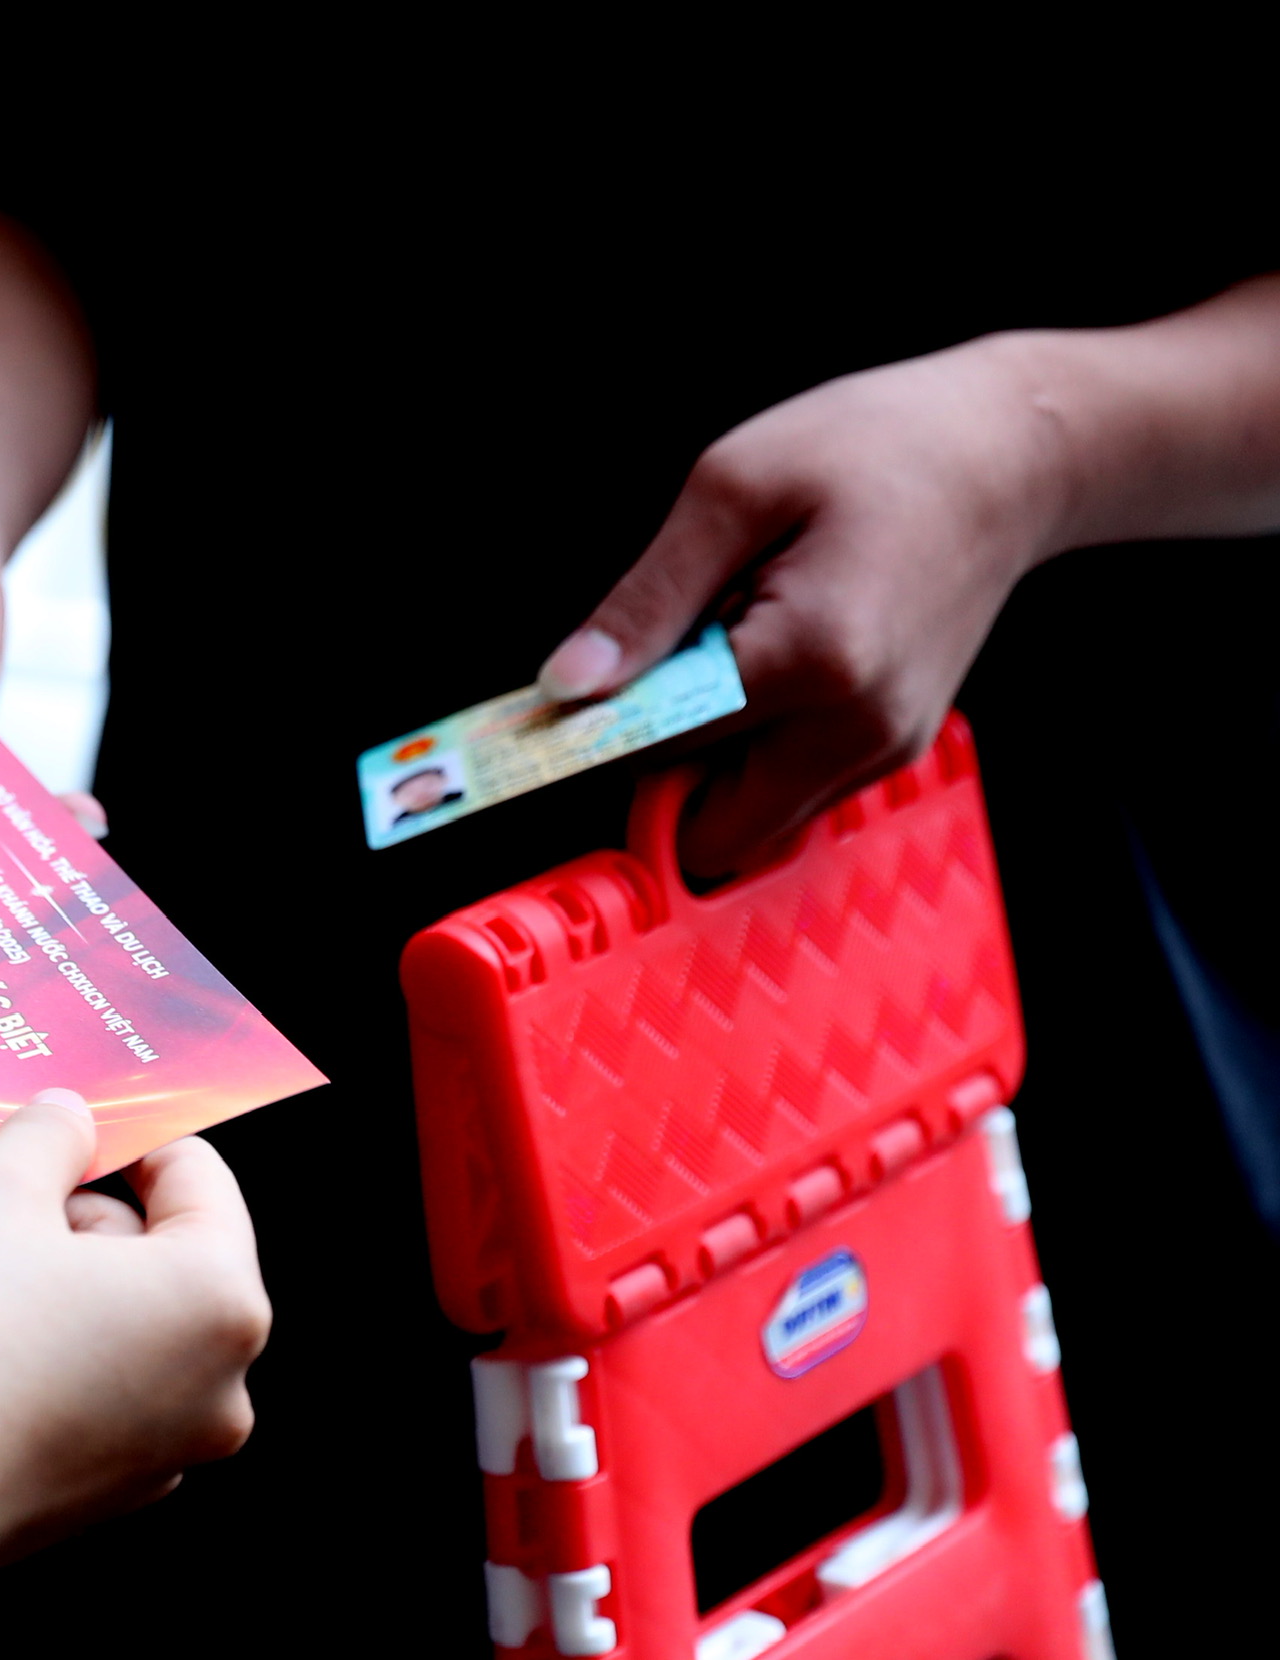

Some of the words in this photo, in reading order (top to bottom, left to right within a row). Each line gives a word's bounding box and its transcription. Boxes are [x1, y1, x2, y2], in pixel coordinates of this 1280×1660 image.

[49, 856, 88, 884] THẾ
[69, 879, 110, 915] THAO
[99, 911, 129, 935] VÀ
[113, 931, 145, 952] DU
[130, 949, 170, 980] LỊCH
[26, 925, 69, 963] NƯỚC
[57, 961, 112, 1011] CHXHCN
[100, 1007, 136, 1036] VIỆT
[121, 1034, 160, 1064] NAM
